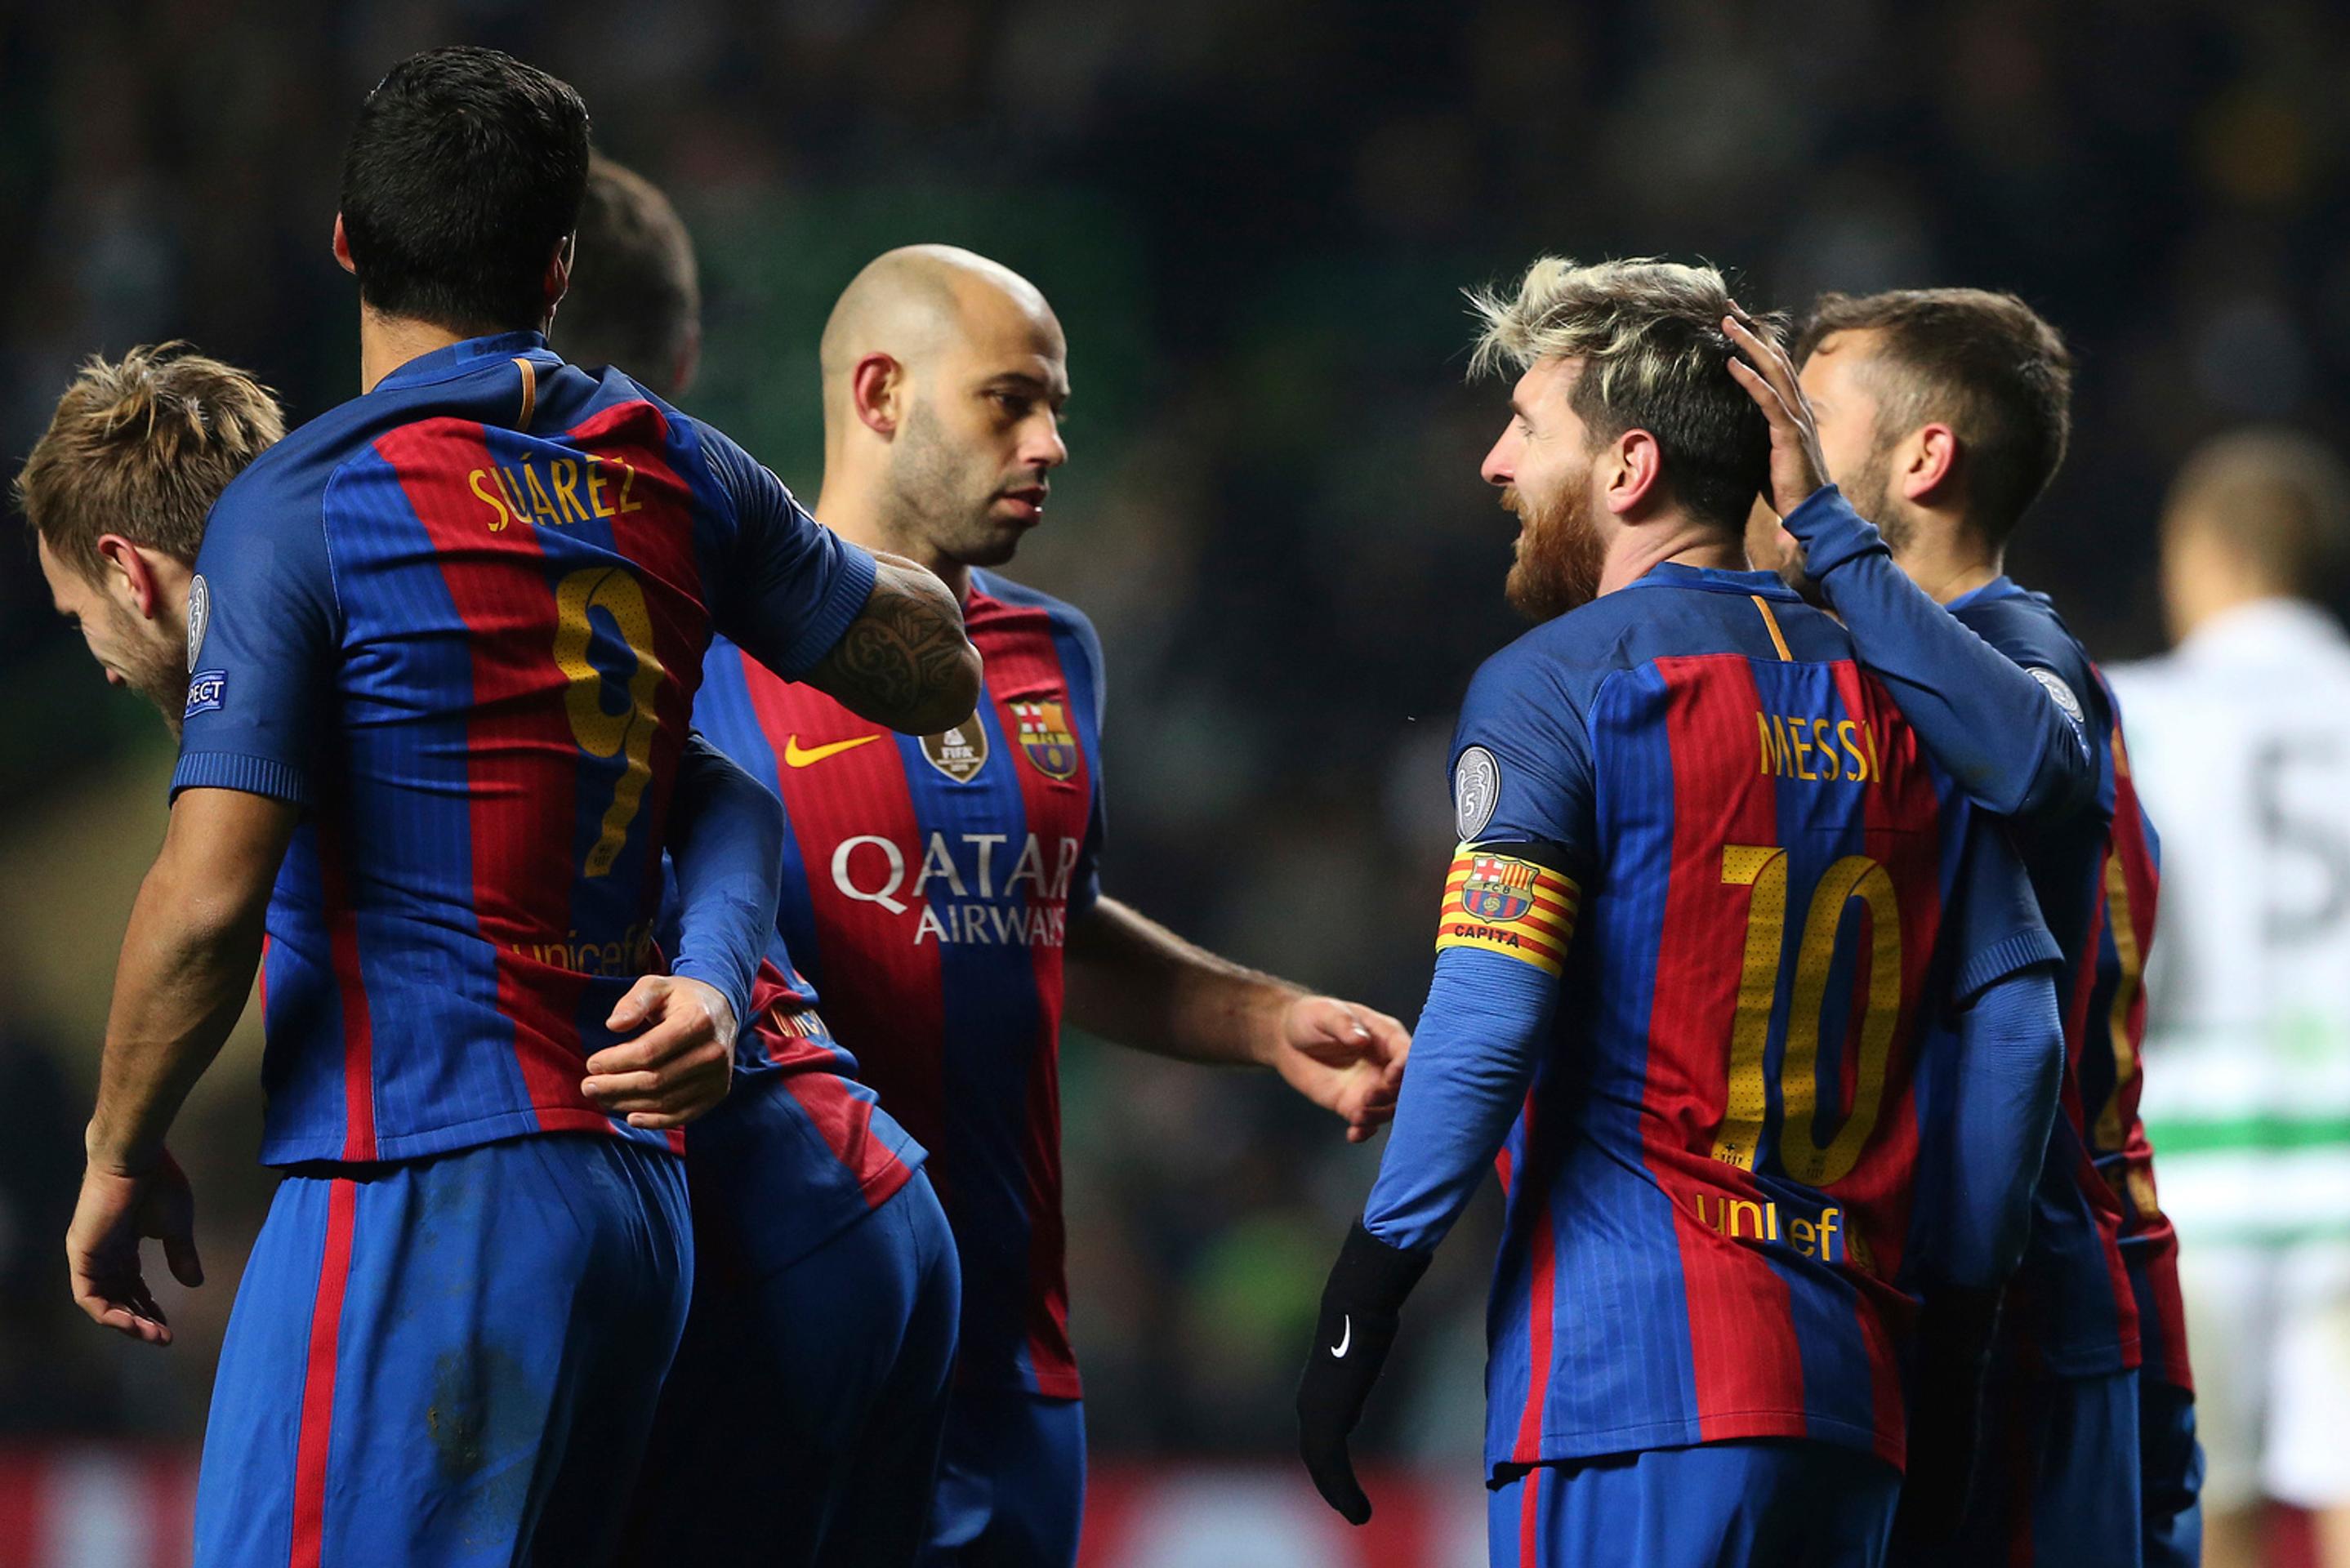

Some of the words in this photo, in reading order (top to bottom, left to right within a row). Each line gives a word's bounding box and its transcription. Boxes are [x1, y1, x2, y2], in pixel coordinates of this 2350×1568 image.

[468, 451, 643, 532] SUÁREZ
[186, 680, 225, 706] PECT
[552, 565, 666, 879] 9
[1755, 710, 1880, 783] MESSI
[830, 831, 1078, 916] QATAR
[1454, 924, 1519, 949] CAPITA
[1710, 844, 1902, 1187] 10
[1696, 1192, 1839, 1263] unief
